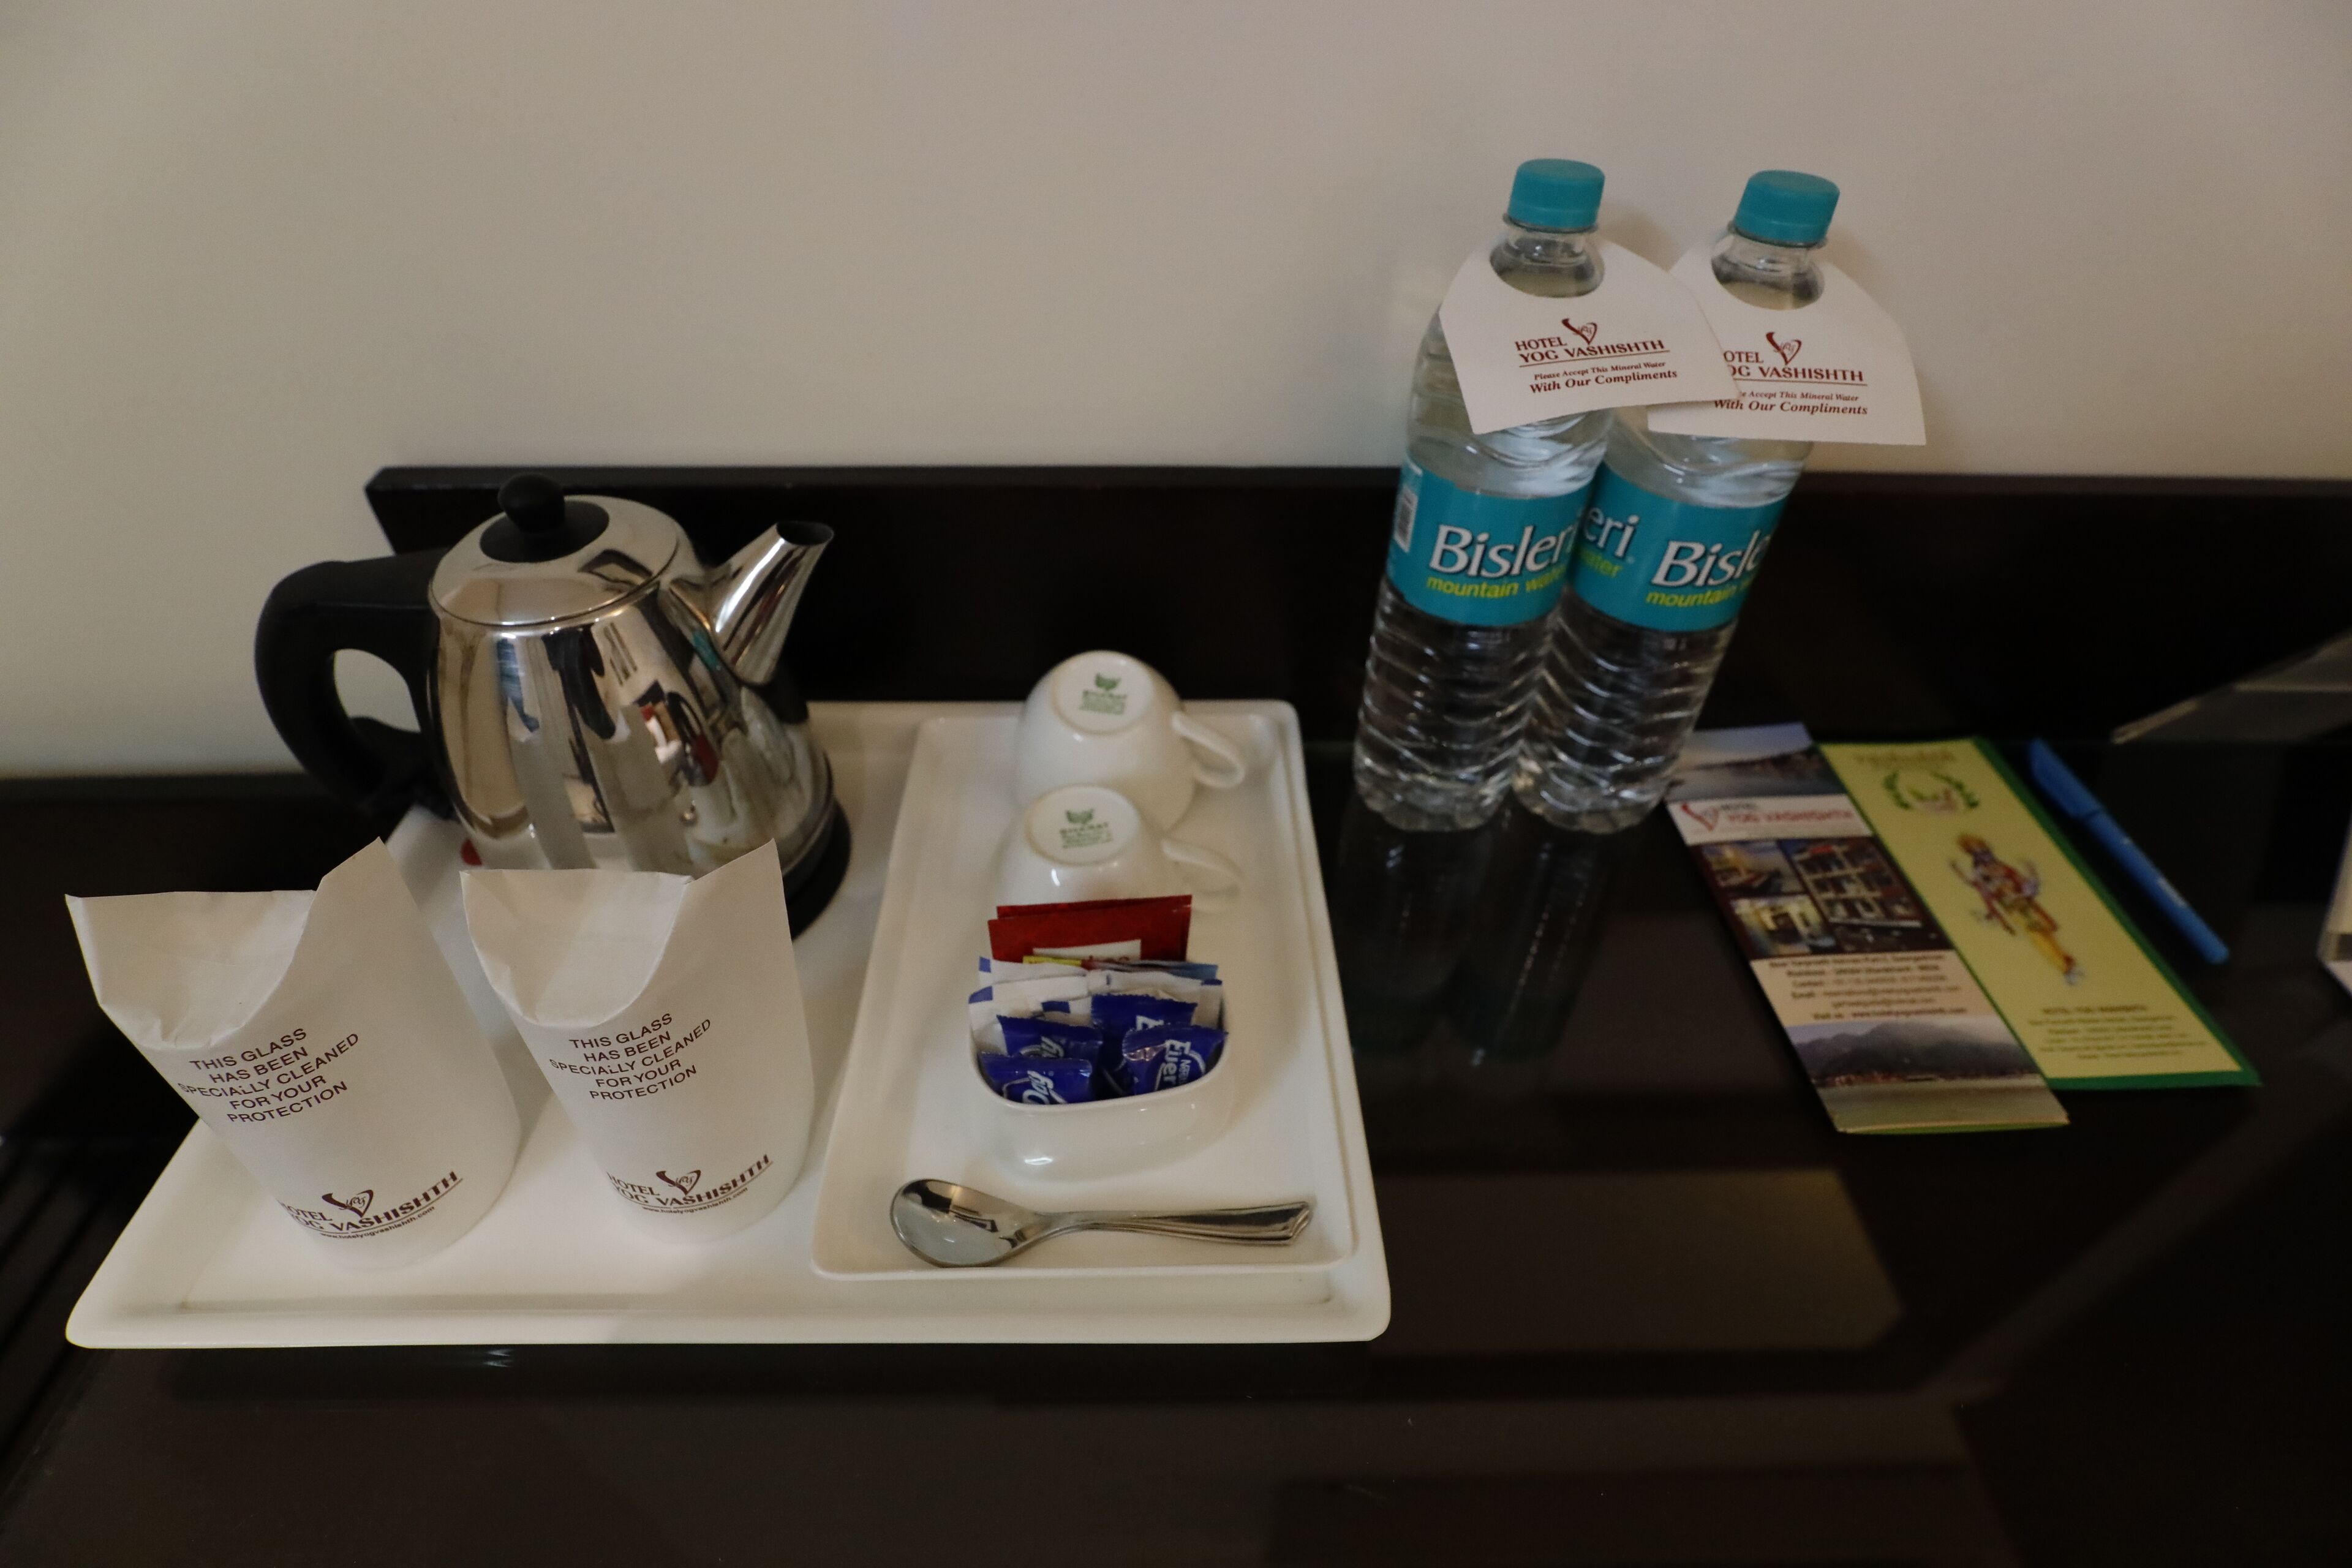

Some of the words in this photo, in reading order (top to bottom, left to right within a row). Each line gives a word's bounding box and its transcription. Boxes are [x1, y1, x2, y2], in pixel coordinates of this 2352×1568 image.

[1515, 336, 1567, 352] HOTEL
[1519, 350, 1559, 363] YOG
[1564, 339, 1665, 359] VASHISHTH
[1722, 350, 1765, 364] OTEL
[1529, 381, 1561, 394] With
[1566, 377, 1591, 389] Our
[1594, 369, 1678, 385] Compliments
[1534, 371, 1561, 381] Please
[1562, 369, 1589, 379] Accept
[1610, 363, 1642, 372] Mineral
[1643, 360, 1666, 369] Water
[1758, 367, 1864, 382] VASHISHTH
[1714, 399, 1744, 411] With
[1749, 400, 1776, 412] Our
[1780, 402, 1868, 415] Compliments
[1749, 391, 1777, 400] Accept
[1779, 390, 1798, 399] This
[1800, 391, 1834, 401] Mineral
[1427, 575, 1520, 598] mountain
[568, 1035, 612, 1049] THIS
[616, 1012, 673, 1044] GLASS
[189, 1055, 237, 1072] THIS
[241, 1027, 308, 1062] GLASS
[549, 1058, 636, 1076] SPECIALLY
[641, 1019, 711, 1067] CLEANED
[583, 1050, 620, 1063] HAS
[625, 1031, 671, 1058] BEEN
[178, 1078, 271, 1098] SPECIALLY
[276, 1033, 360, 1085] CLEANED
[209, 1068, 251, 1085] HAS
[254, 1046, 308, 1077] BEEN
[595, 1076, 632, 1088] FOR
[633, 1058, 682, 1084] YOUR
[229, 1095, 271, 1110] FOR
[271, 1074, 328, 1102] YOUR
[589, 1065, 698, 1101] PROTECTION
[227, 1080, 349, 1123] PROTECTION
[655, 1154, 769, 1207] VASHISHTH
[330, 1170, 458, 1232] VASHISHTH
